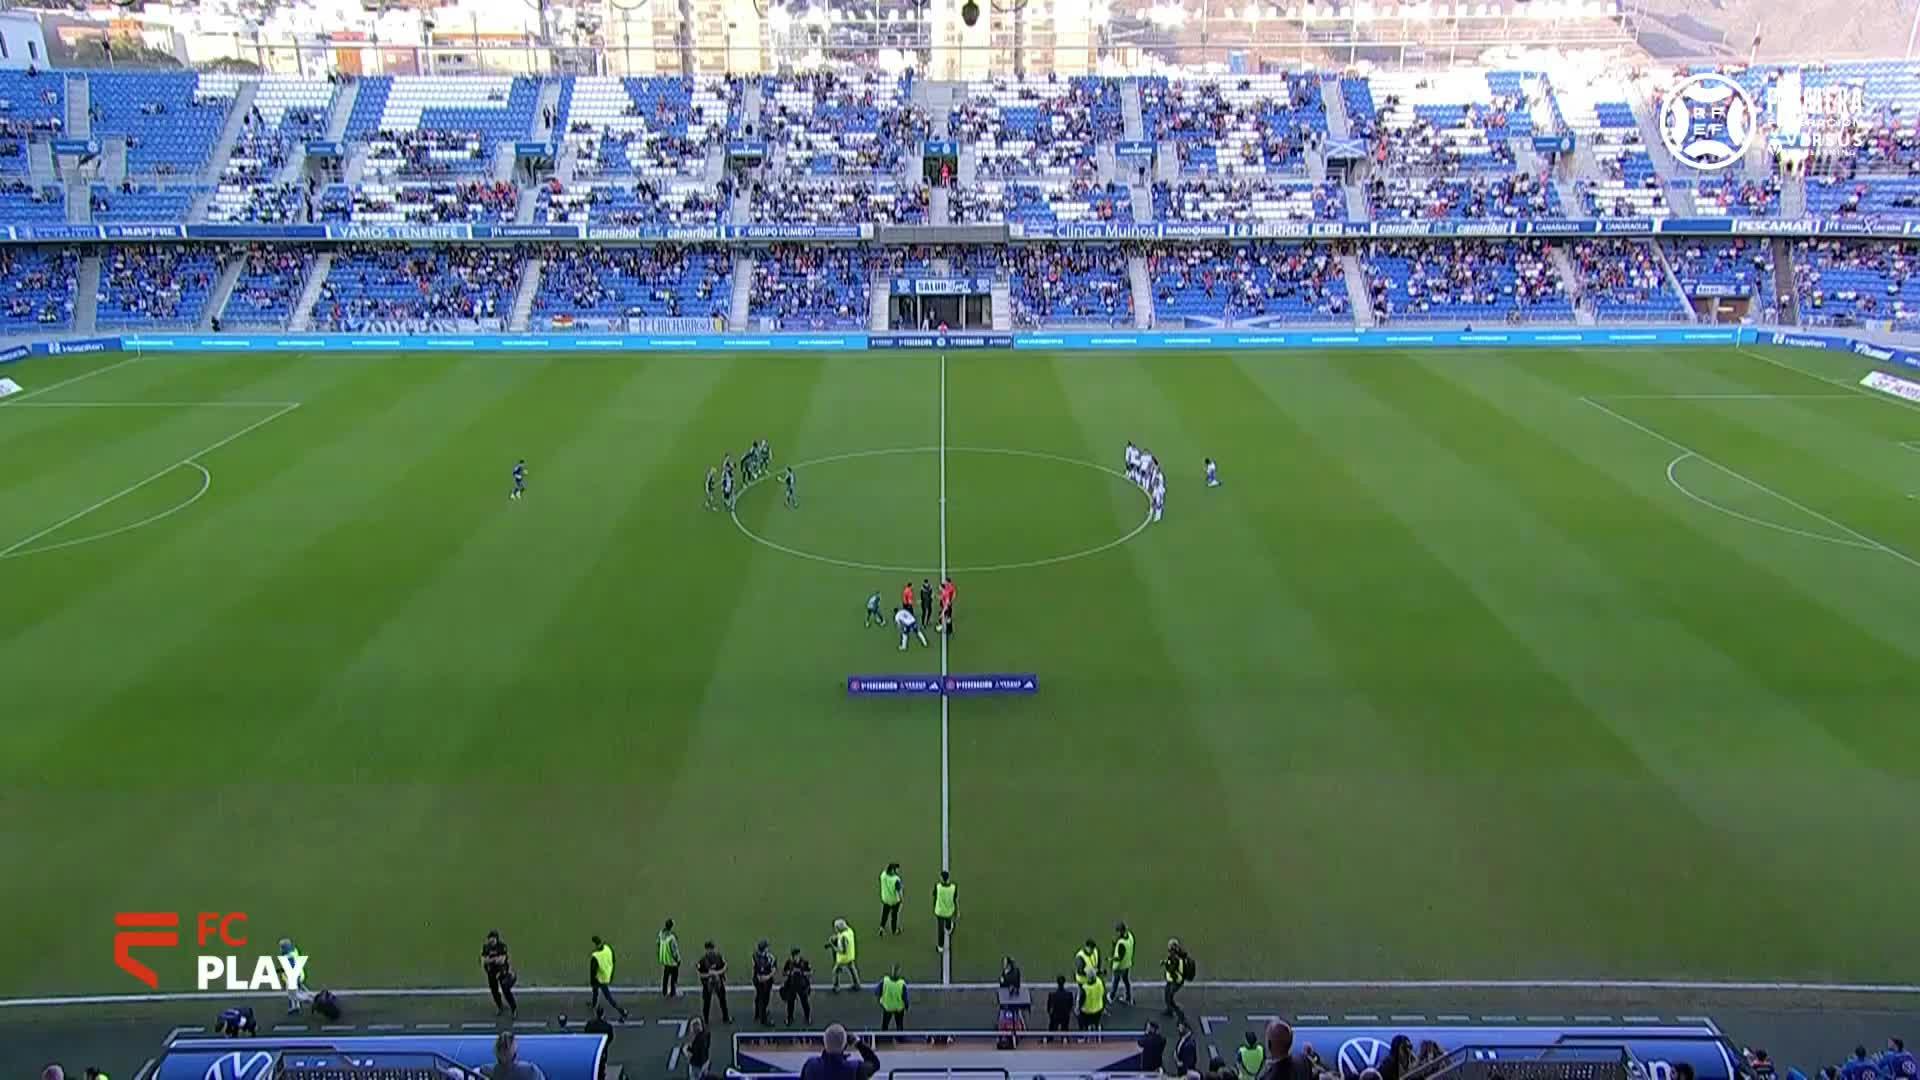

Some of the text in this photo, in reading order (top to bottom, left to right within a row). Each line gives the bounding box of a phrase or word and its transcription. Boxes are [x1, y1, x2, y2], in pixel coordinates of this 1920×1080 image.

[122, 225, 176, 236] MAPFRE
[748, 226, 778, 236] GRUPO
[780, 226, 814, 236] FUMERO
[1738, 219, 1813, 232] PESCAMAR
[340, 227, 458, 238] VAMOS TENERIFE
